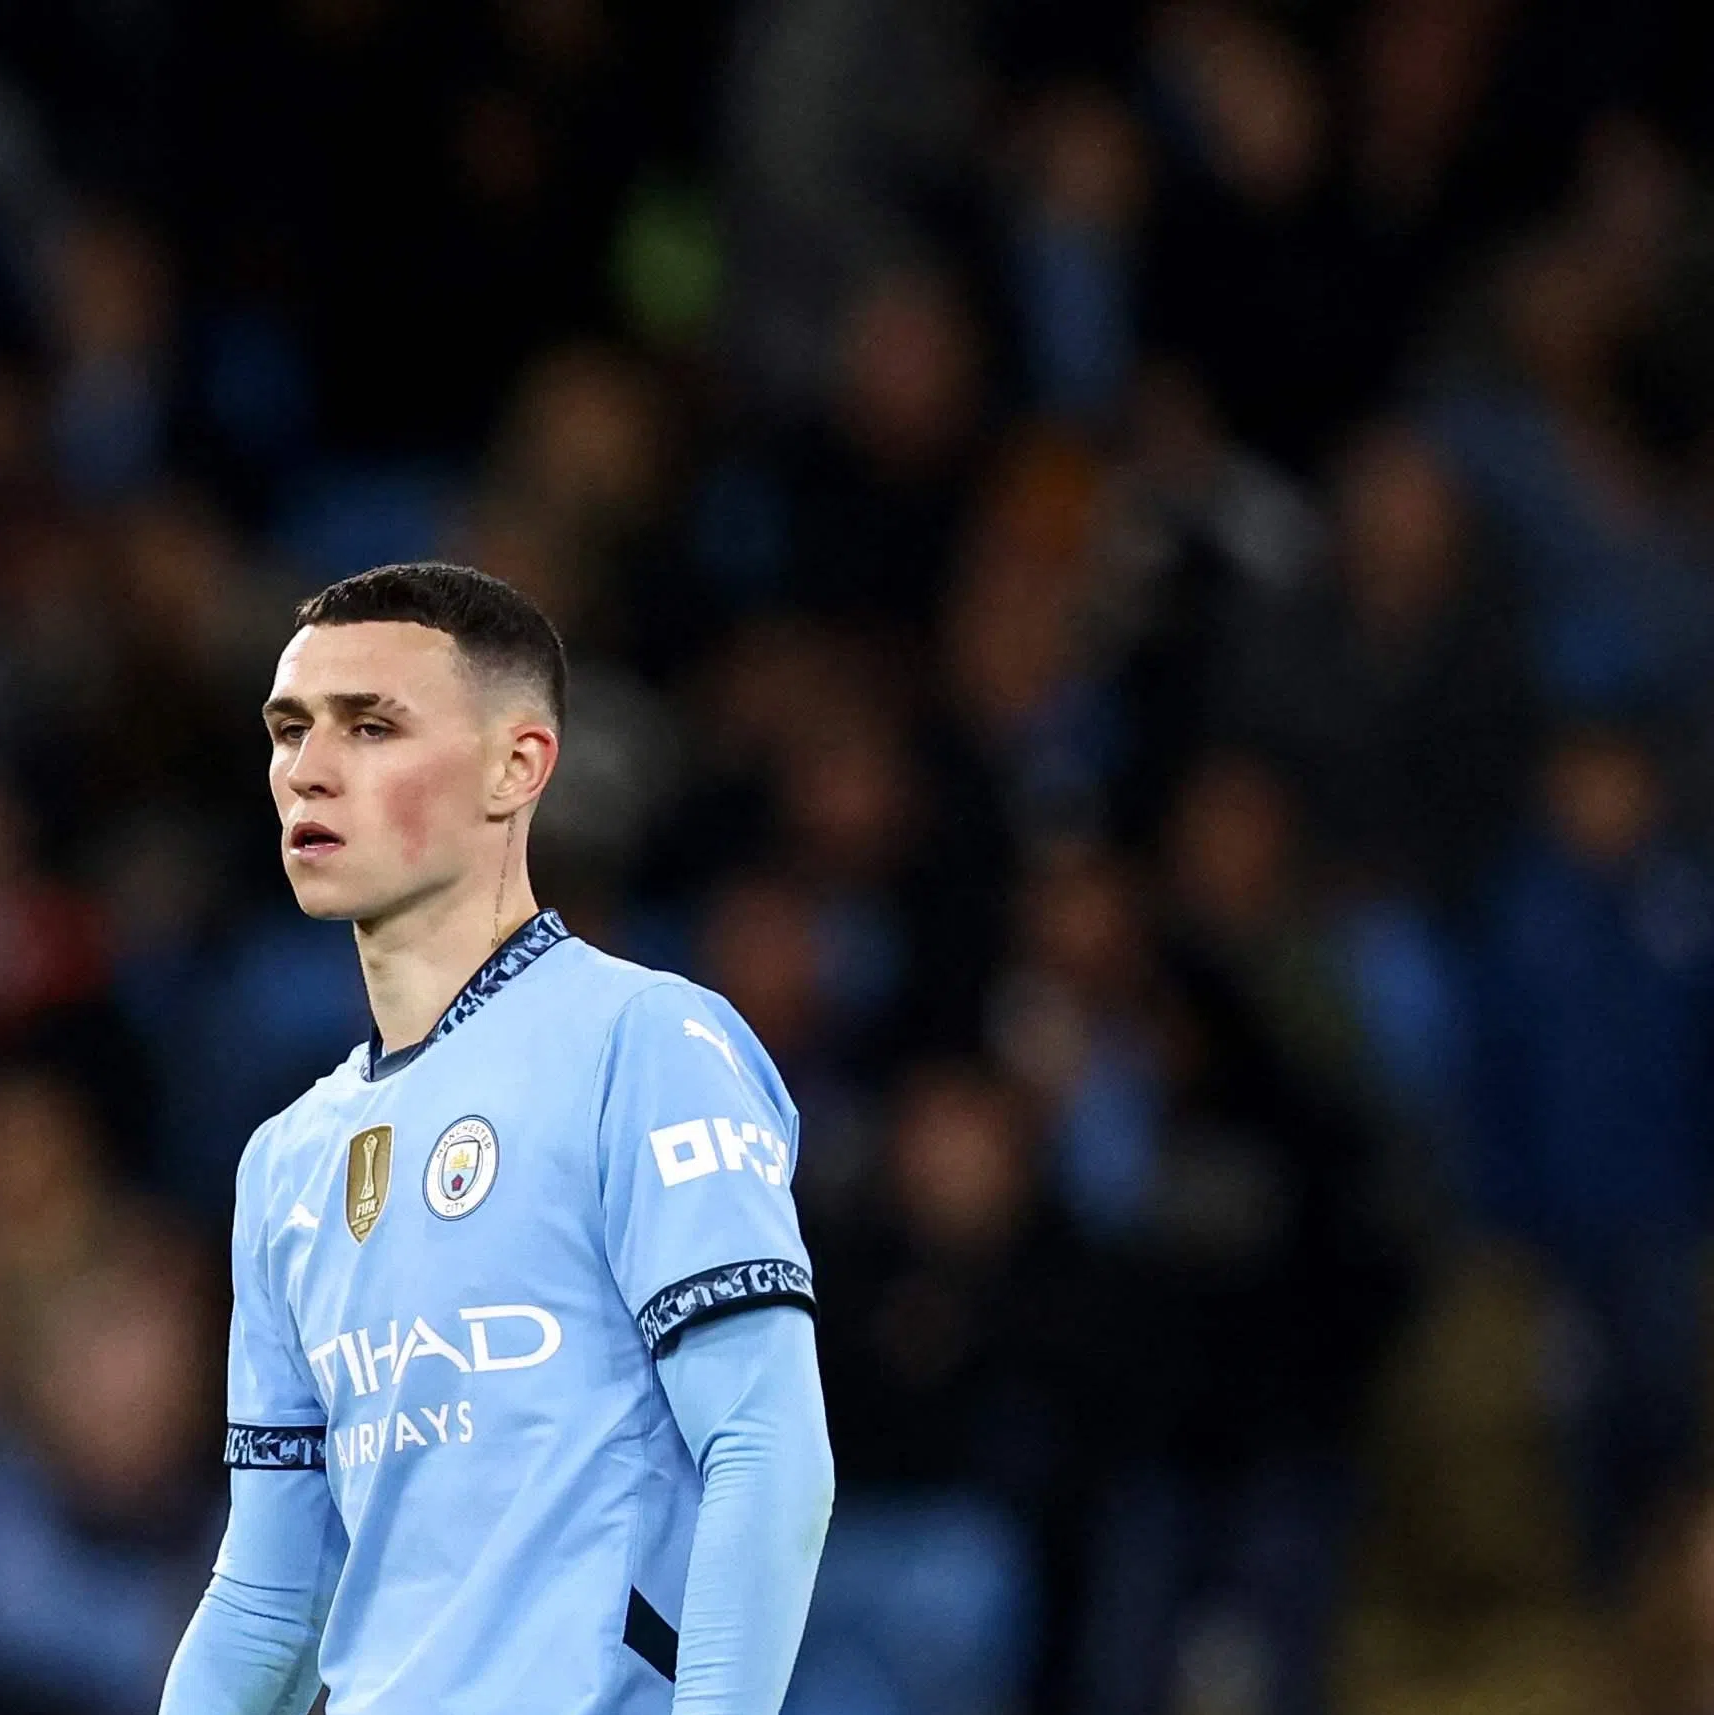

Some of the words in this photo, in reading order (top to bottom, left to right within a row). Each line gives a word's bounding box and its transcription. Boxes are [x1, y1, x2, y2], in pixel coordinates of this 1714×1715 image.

[437, 1125, 492, 1159] MANCHESTER
[356, 1200, 379, 1218] FIFA
[445, 1202, 466, 1214] CITY
